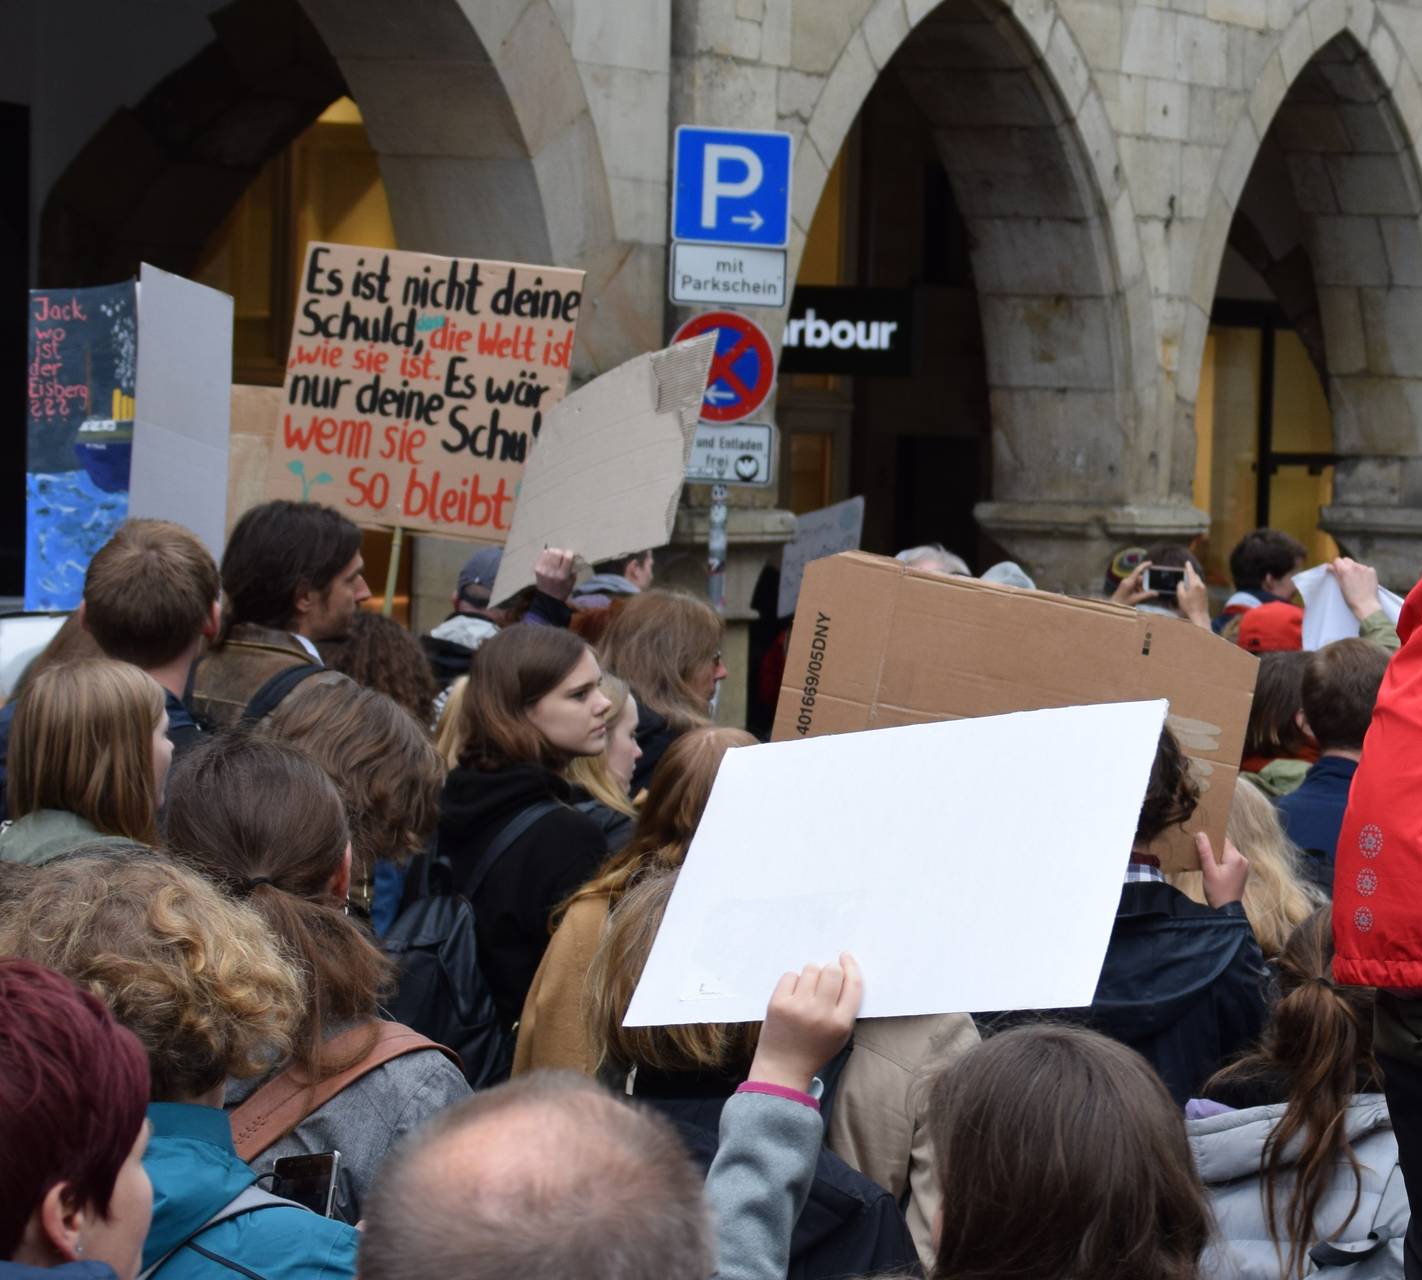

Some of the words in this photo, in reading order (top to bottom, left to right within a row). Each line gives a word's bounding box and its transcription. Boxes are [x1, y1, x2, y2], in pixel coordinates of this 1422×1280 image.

[701, 143, 763, 228] P
[716, 259, 743, 273] mit
[306, 248, 343, 296] Es
[352, 256, 390, 302] ist
[402, 260, 483, 314] nicht
[491, 268, 582, 322] deine
[681, 275, 777, 294] Parkschein
[36, 328, 65, 342] wo
[36, 338, 62, 359] ist
[430, 319, 472, 352] die
[477, 322, 536, 362] Welt
[543, 328, 573, 370] ist
[29, 357, 63, 377] der
[352, 344, 389, 373] sie
[400, 349, 442, 381] ist.
[29, 377, 89, 410] Eisberg
[444, 356, 477, 399] Es
[486, 370, 549, 407] wär
[289, 374, 351, 409] nur
[355, 374, 445, 426] deine
[283, 414, 372, 460] wenn
[380, 420, 426, 465] sie
[719, 436, 763, 452] Entladen
[706, 454, 729, 467] frei
[796, 612, 831, 735] 401669/05DNY
